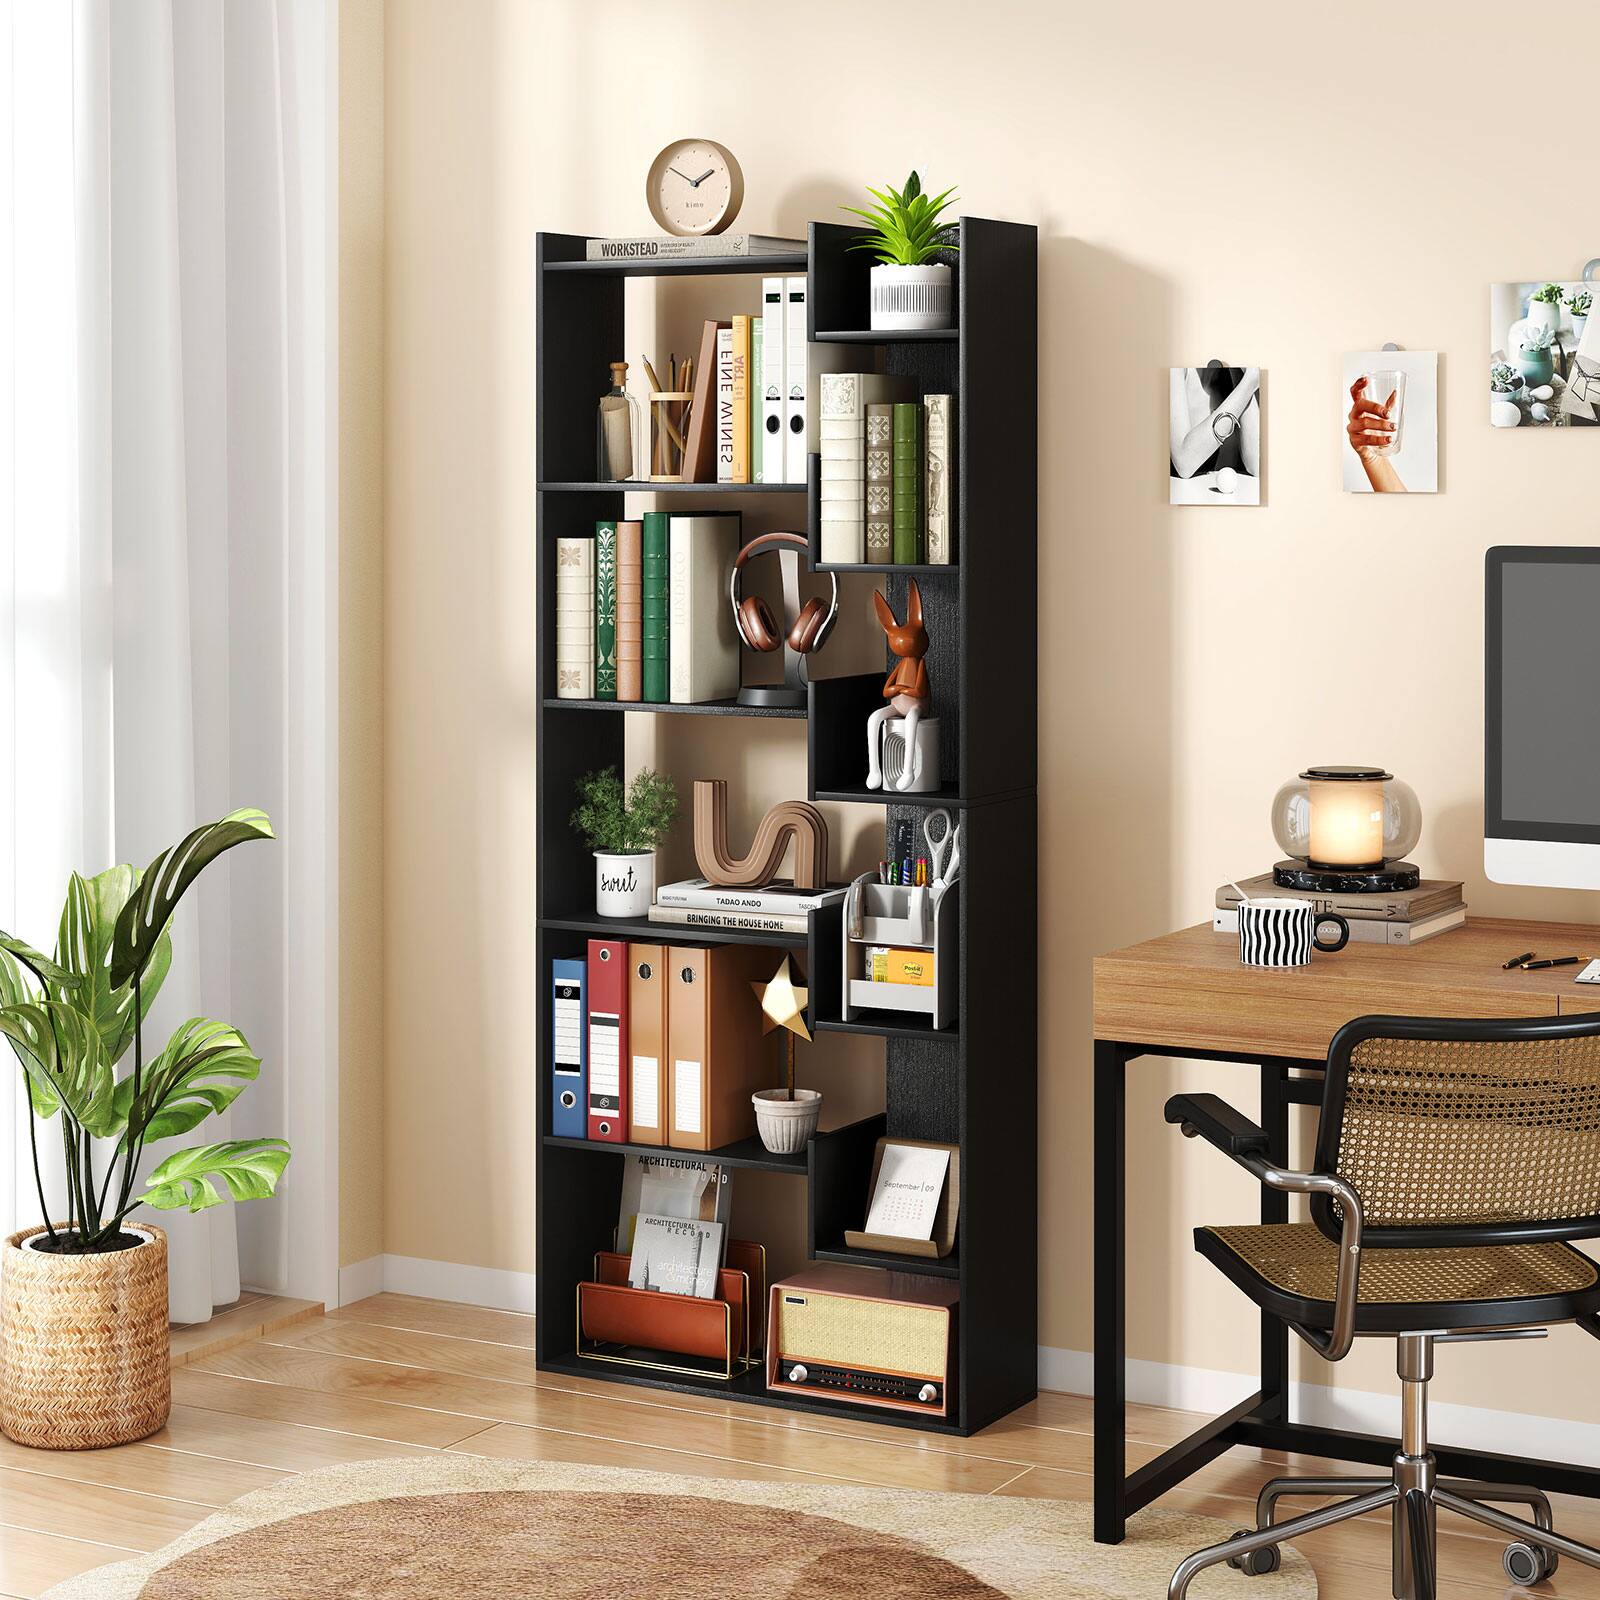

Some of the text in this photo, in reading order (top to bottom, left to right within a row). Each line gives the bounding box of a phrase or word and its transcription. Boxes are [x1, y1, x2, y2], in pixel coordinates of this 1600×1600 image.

[601, 241, 658, 257] WORKSTEAD
[601, 865, 638, 892] sweet
[716, 897, 762, 908] TADAO ANDO
[687, 913, 784, 930] BRINGING THE HOUSE HOME
[639, 1155, 707, 1172] ARCHITECTURAL
[670, 1167, 728, 1184] REORD
[883, 1180, 935, 1193] September 09
[645, 1217, 696, 1231] ARCHITECTURAL
[667, 1227, 711, 1239] RECORD
